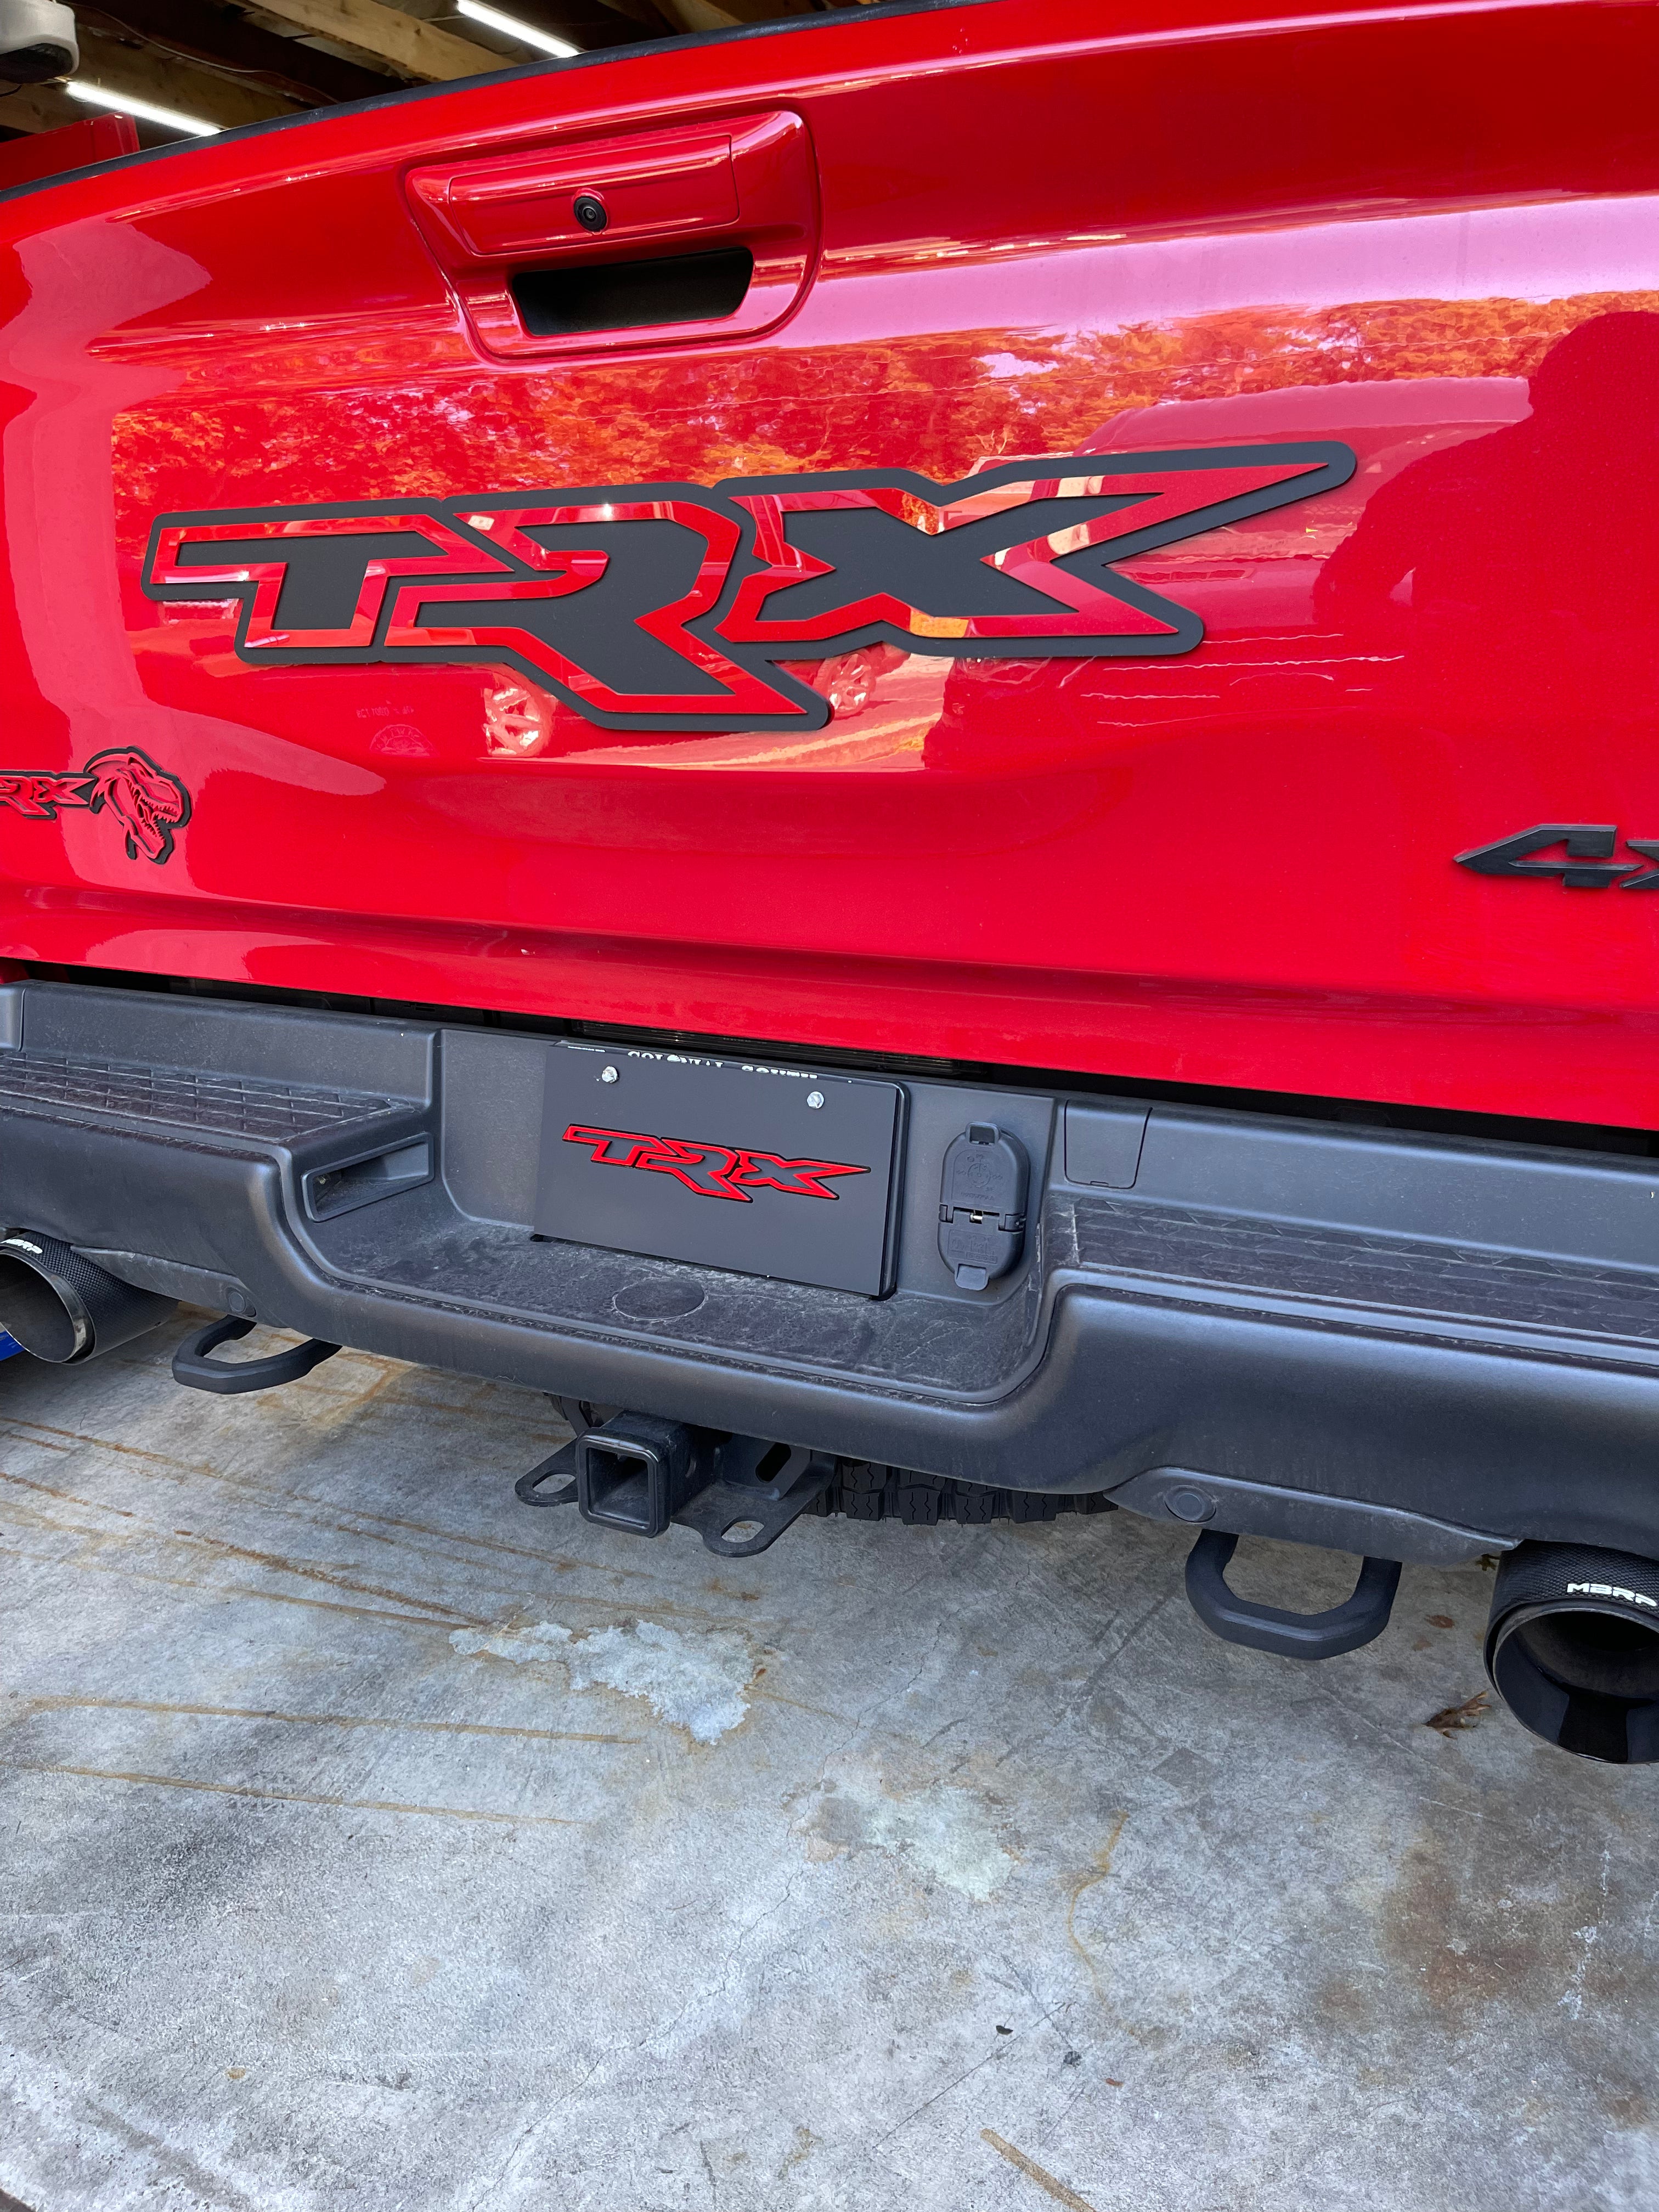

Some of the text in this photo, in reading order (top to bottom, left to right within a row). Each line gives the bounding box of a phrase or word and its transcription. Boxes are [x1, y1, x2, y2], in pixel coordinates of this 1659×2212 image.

[144, 441, 1356, 732] TRX
[0, 771, 97, 817] RX
[562, 1124, 871, 1203] TRX
[1567, 1583, 1657, 1607] MBRP
